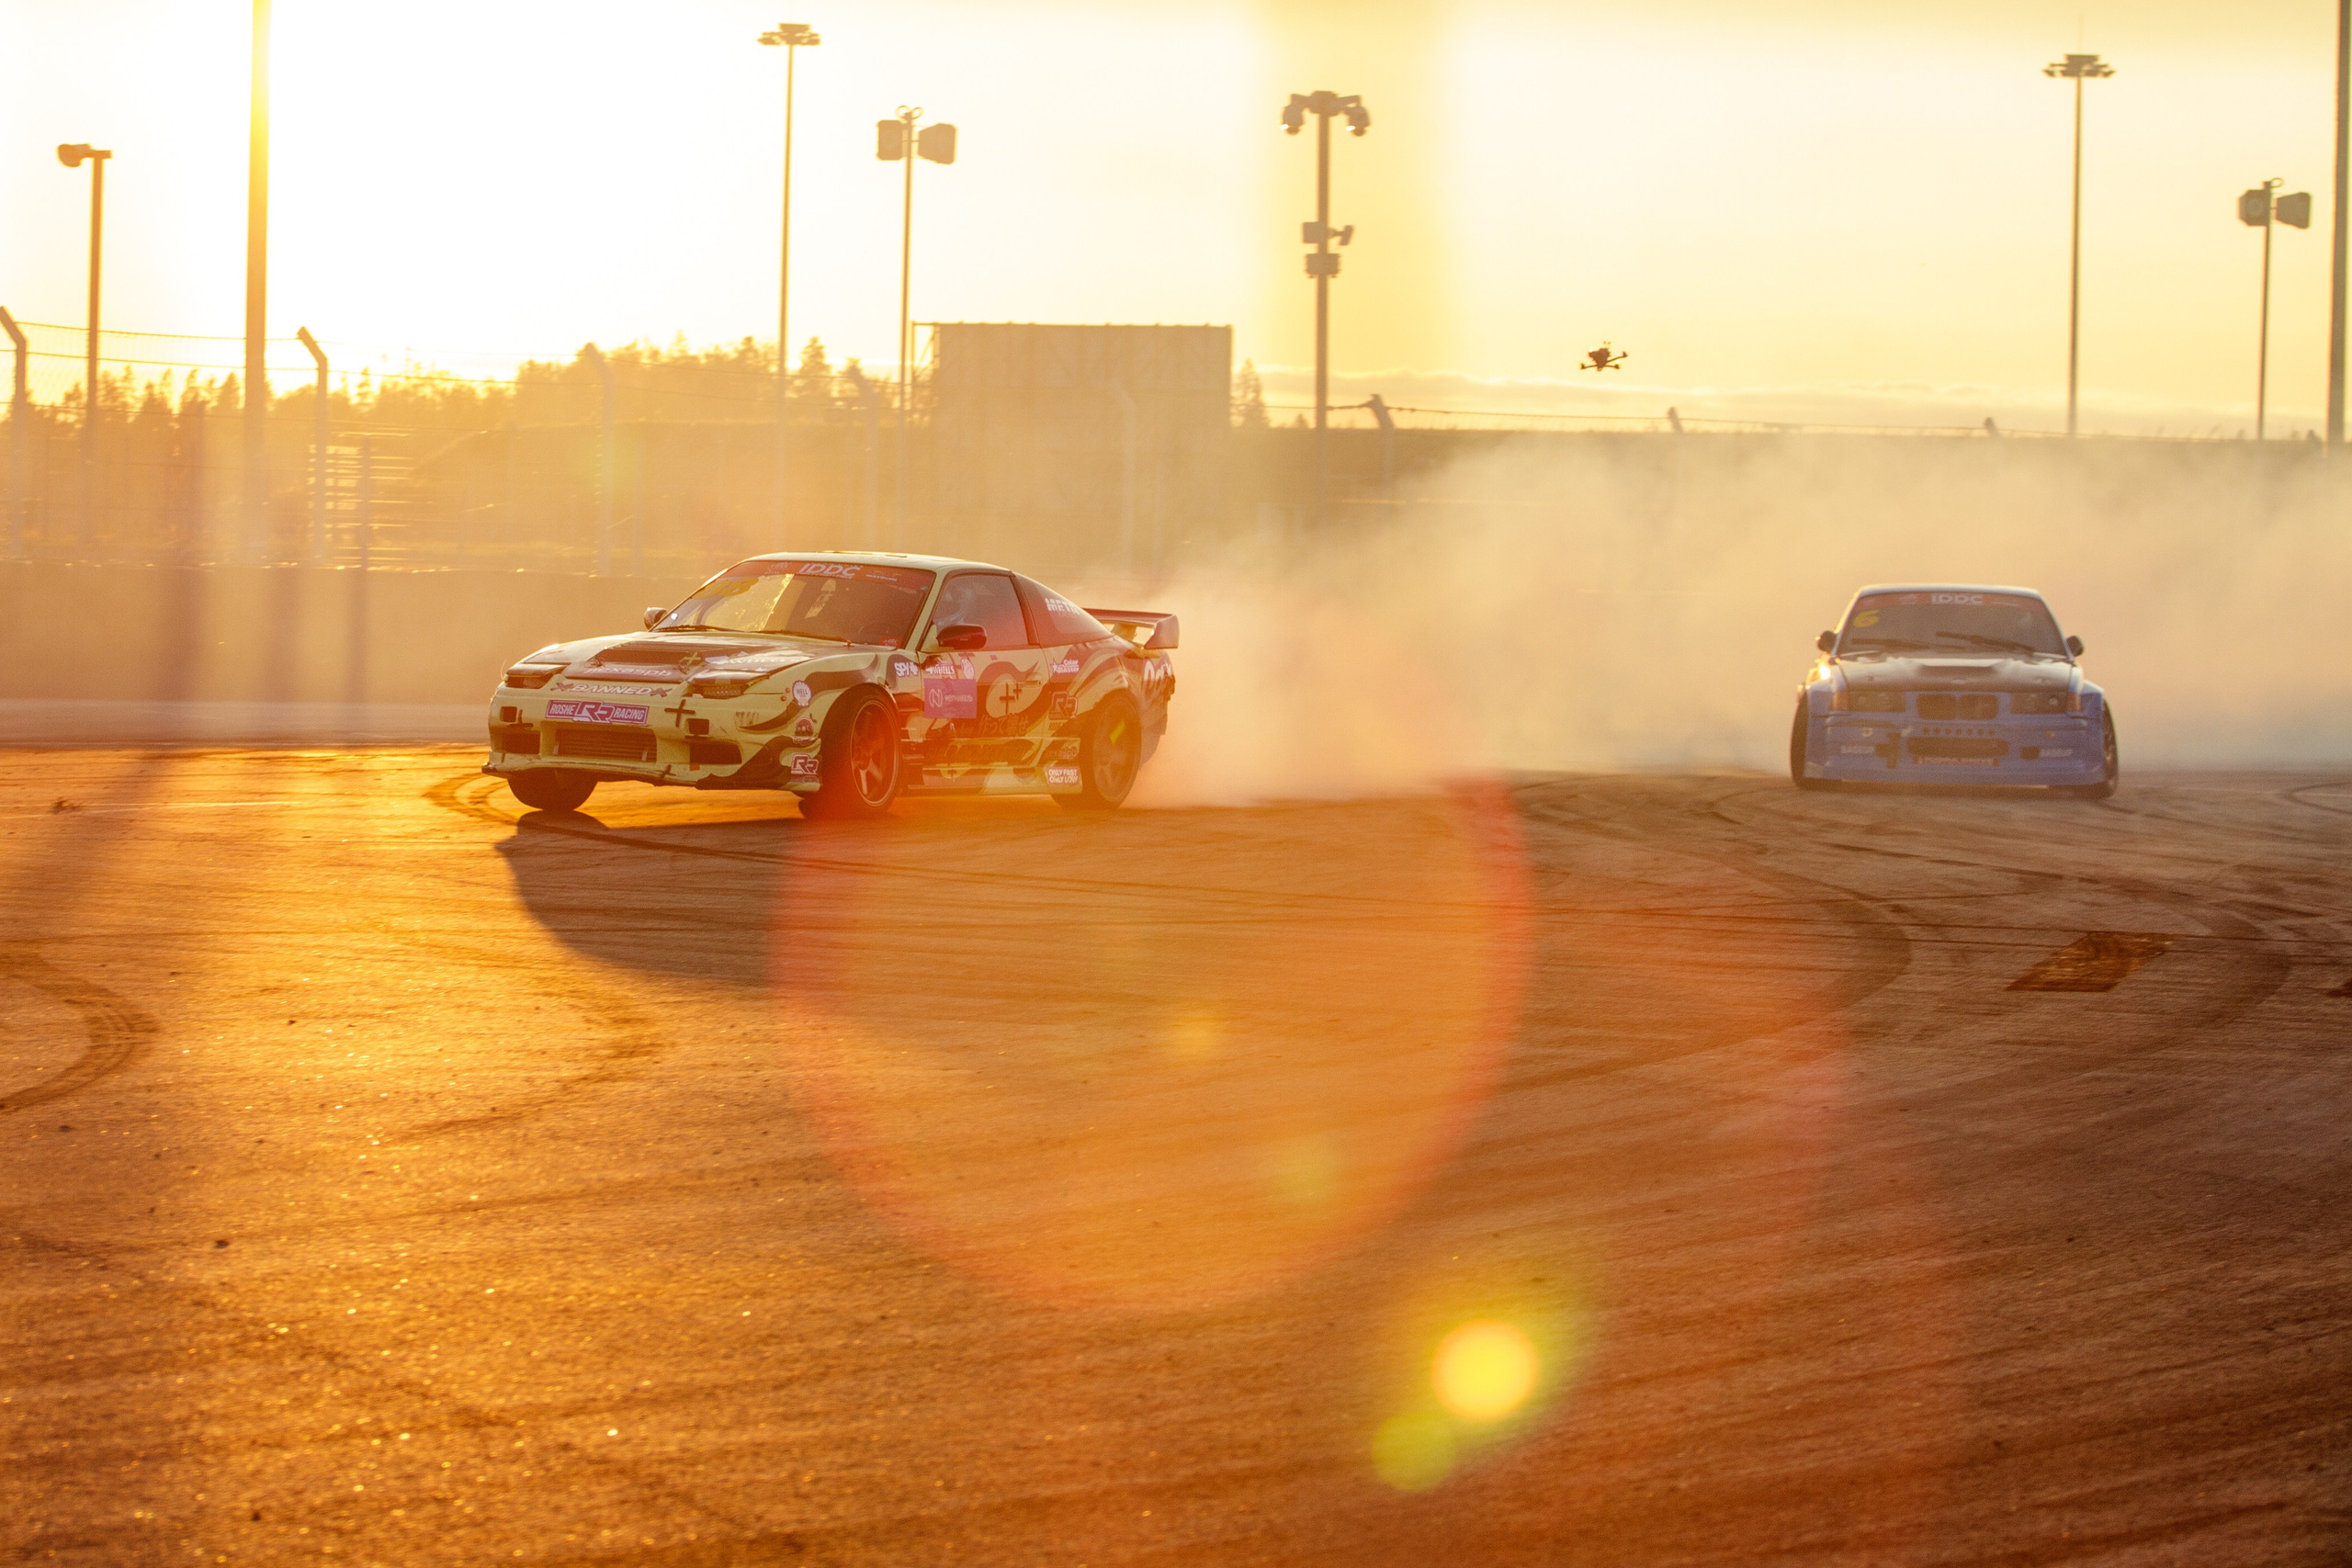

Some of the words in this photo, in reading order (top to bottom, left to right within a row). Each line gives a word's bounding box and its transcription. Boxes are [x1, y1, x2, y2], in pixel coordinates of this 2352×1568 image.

[798, 563, 862, 578] IDDC
[1930, 593, 1983, 604] IDDC
[1853, 609, 1880, 628] 6
[571, 683, 653, 695] BANNED
[549, 704, 576, 715] ROSHE
[613, 707, 646, 720] RACING
[1047, 768, 1063, 776] ONLY
[1062, 769, 1078, 777] FAST
[1048, 775, 1064, 784] ONLY
[1064, 776, 1079, 784] LOW
